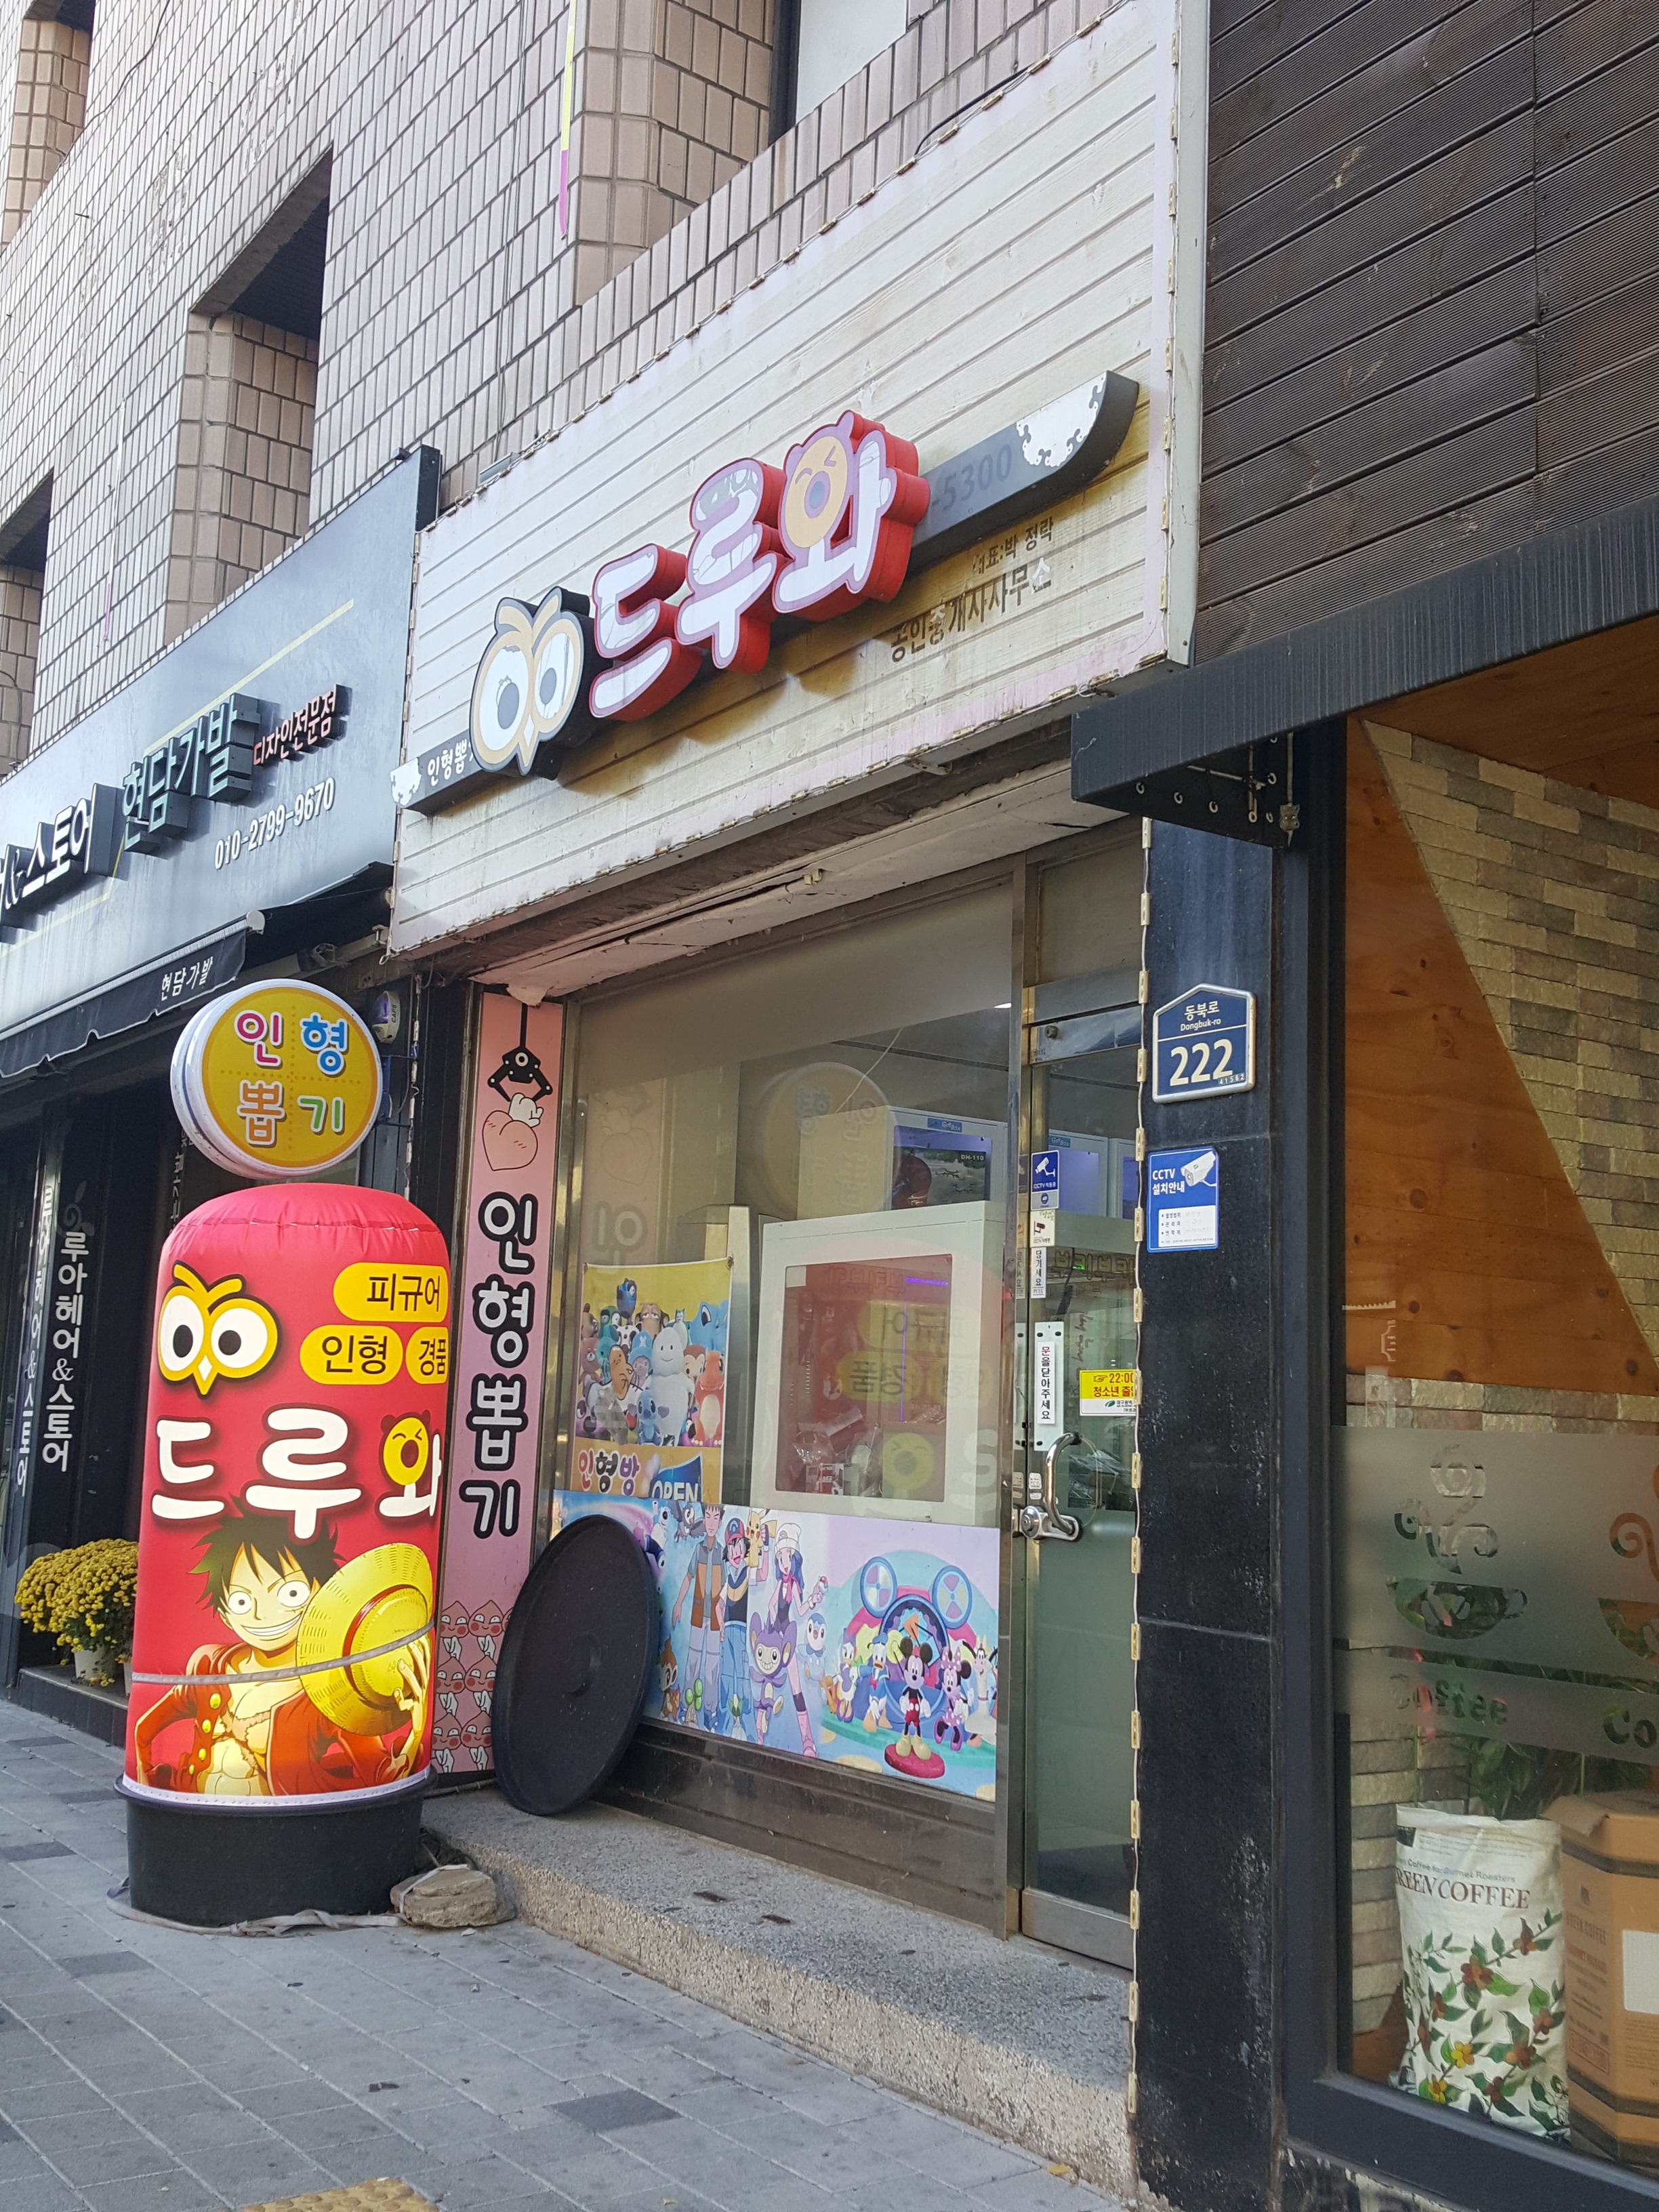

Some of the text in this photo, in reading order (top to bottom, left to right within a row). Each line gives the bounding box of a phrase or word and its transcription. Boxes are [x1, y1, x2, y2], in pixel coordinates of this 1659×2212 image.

[590, 410, 903, 718] 드루와
[253, 684, 337, 766] 디자인전문점
[123, 693, 239, 852] 현담가발
[428, 739, 474, 786] 인형뽑
[214, 777, 335, 870] 010-2799-9670
[161, 956, 213, 1001] 현담가발
[1180, 1018, 1221, 1032] Dongbuk-ro
[1185, 1000, 1220, 1021] 동북로
[234, 1010, 348, 1076] 인형
[1170, 1038, 1233, 1087] 222
[1218, 1073, 1246, 1085] 41562
[237, 1080, 344, 1145] 뽑기
[1152, 1181, 1185, 1195] 설치안내
[1153, 1168, 1176, 1181] CCTV
[367, 1274, 441, 1313] 피규어
[41, 1231, 89, 1472] 루아헤어&스토어
[321, 1334, 447, 1376] 인형 경품
[462, 1195, 535, 1536] 인형뽑기
[1041, 1346, 1050, 1420] 문을닫아주세요
[1093, 1386, 1120, 1397] 청소년
[152, 1408, 441, 1539] 드루와
[578, 1448, 641, 1496] 인형방
[651, 1480, 699, 1502] OPEN
[1395, 1866, 1531, 1909] REEN COFFEE
[1408, 1858, 1431, 1871] Coffee
